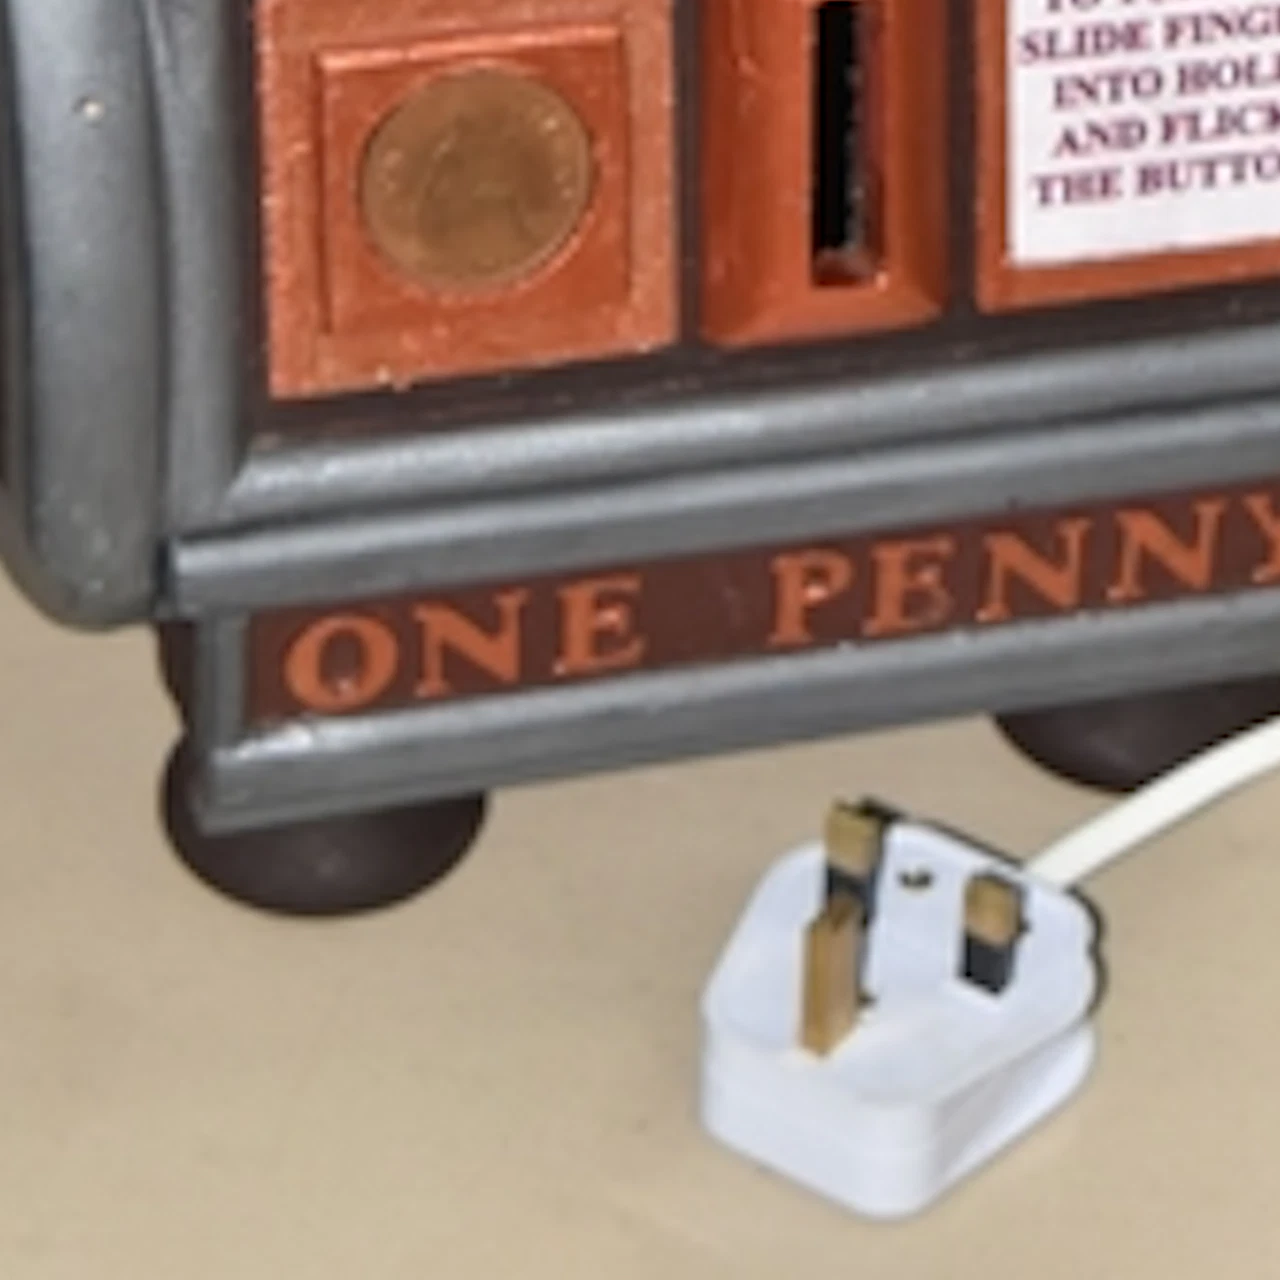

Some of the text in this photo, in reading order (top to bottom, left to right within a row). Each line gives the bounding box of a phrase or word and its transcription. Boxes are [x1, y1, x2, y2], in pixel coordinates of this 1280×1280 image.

[1020, 18, 1152, 65] SLIDE
[1052, 67, 1165, 112] INTO
[1052, 116, 1149, 158] AND
[1031, 166, 1123, 209] THE
[284, 575, 644, 713] ONE
